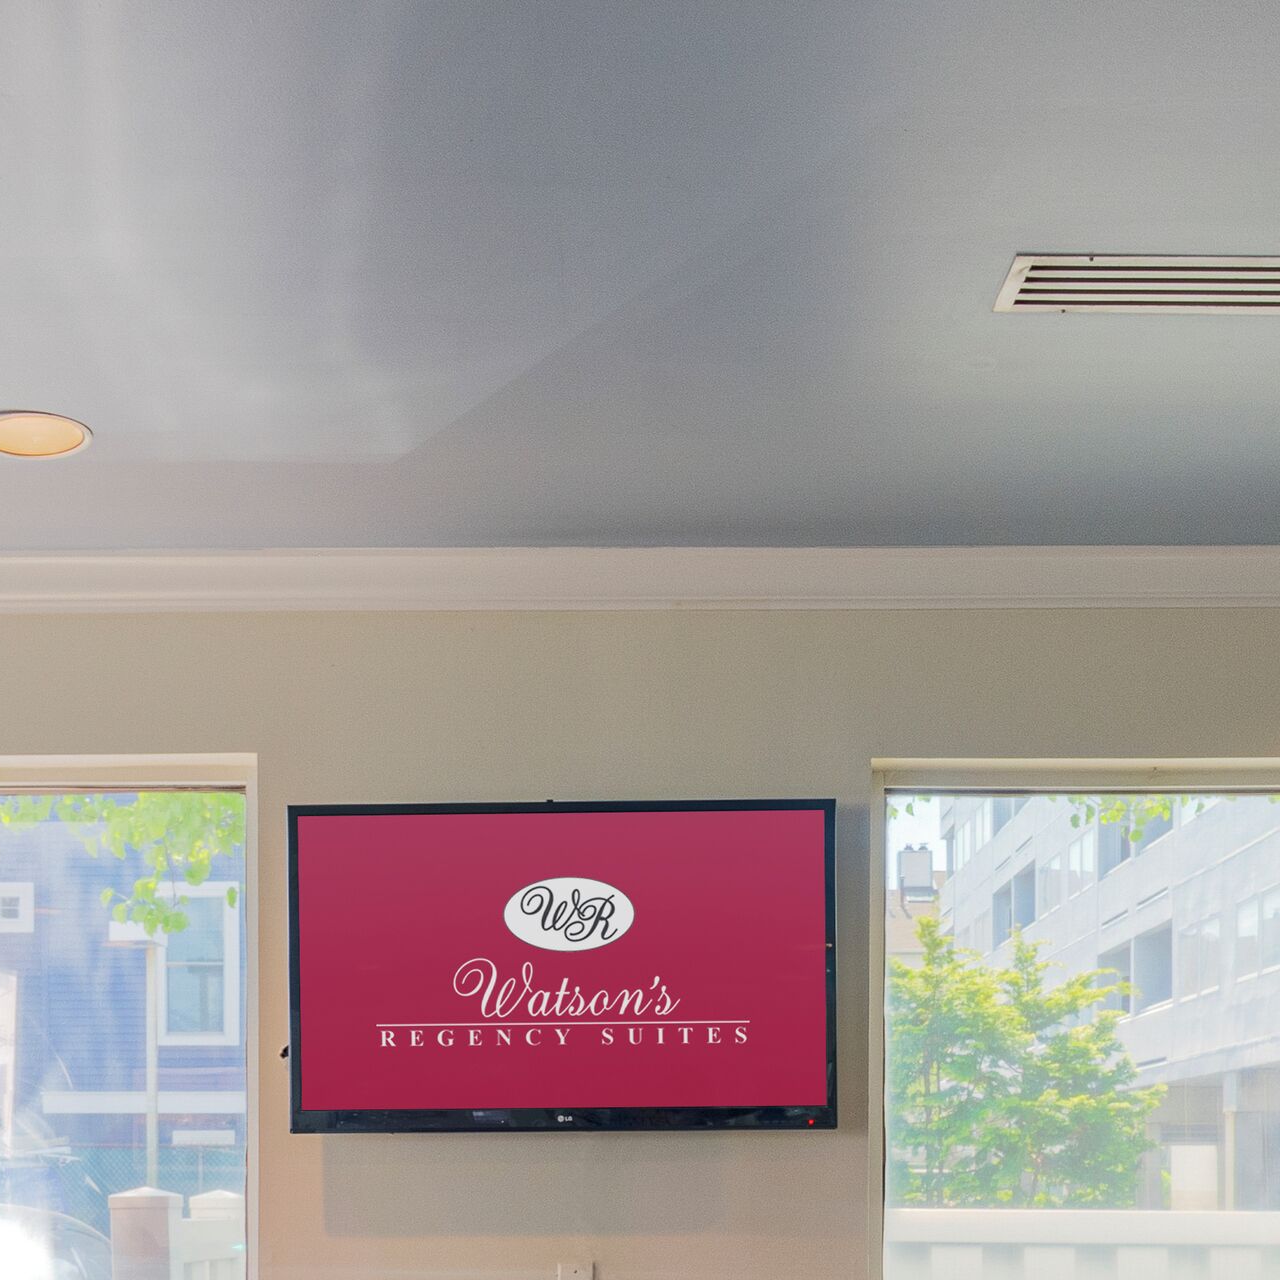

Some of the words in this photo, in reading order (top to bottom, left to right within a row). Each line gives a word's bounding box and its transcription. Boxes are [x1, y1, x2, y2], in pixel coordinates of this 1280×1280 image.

[453, 957, 681, 1018] Watson's
[379, 1028, 571, 1048] REGENCY
[601, 1026, 749, 1046] SUITES
